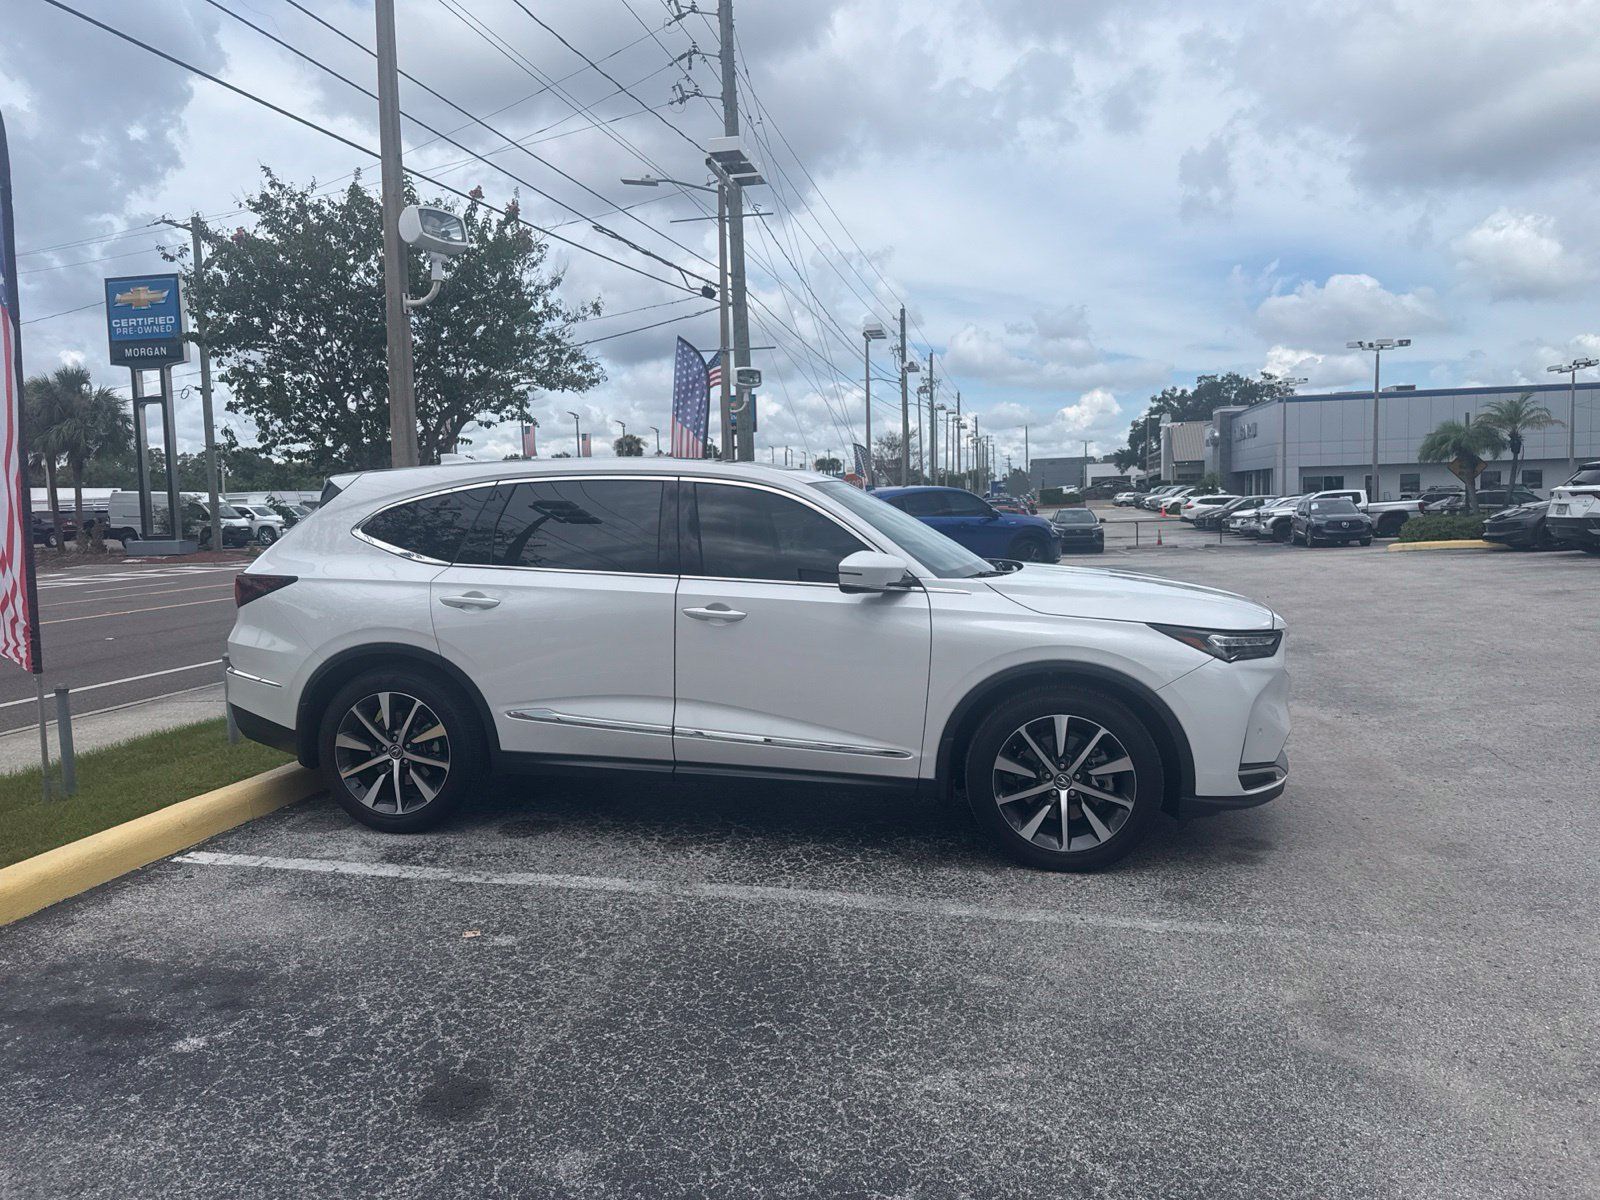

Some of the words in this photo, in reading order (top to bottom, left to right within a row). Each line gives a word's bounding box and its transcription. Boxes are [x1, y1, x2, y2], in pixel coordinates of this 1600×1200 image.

[112, 316, 175, 327] CERTIFIED
[116, 325, 172, 335] PRE-OWNED
[124, 346, 167, 357] MORGAN
